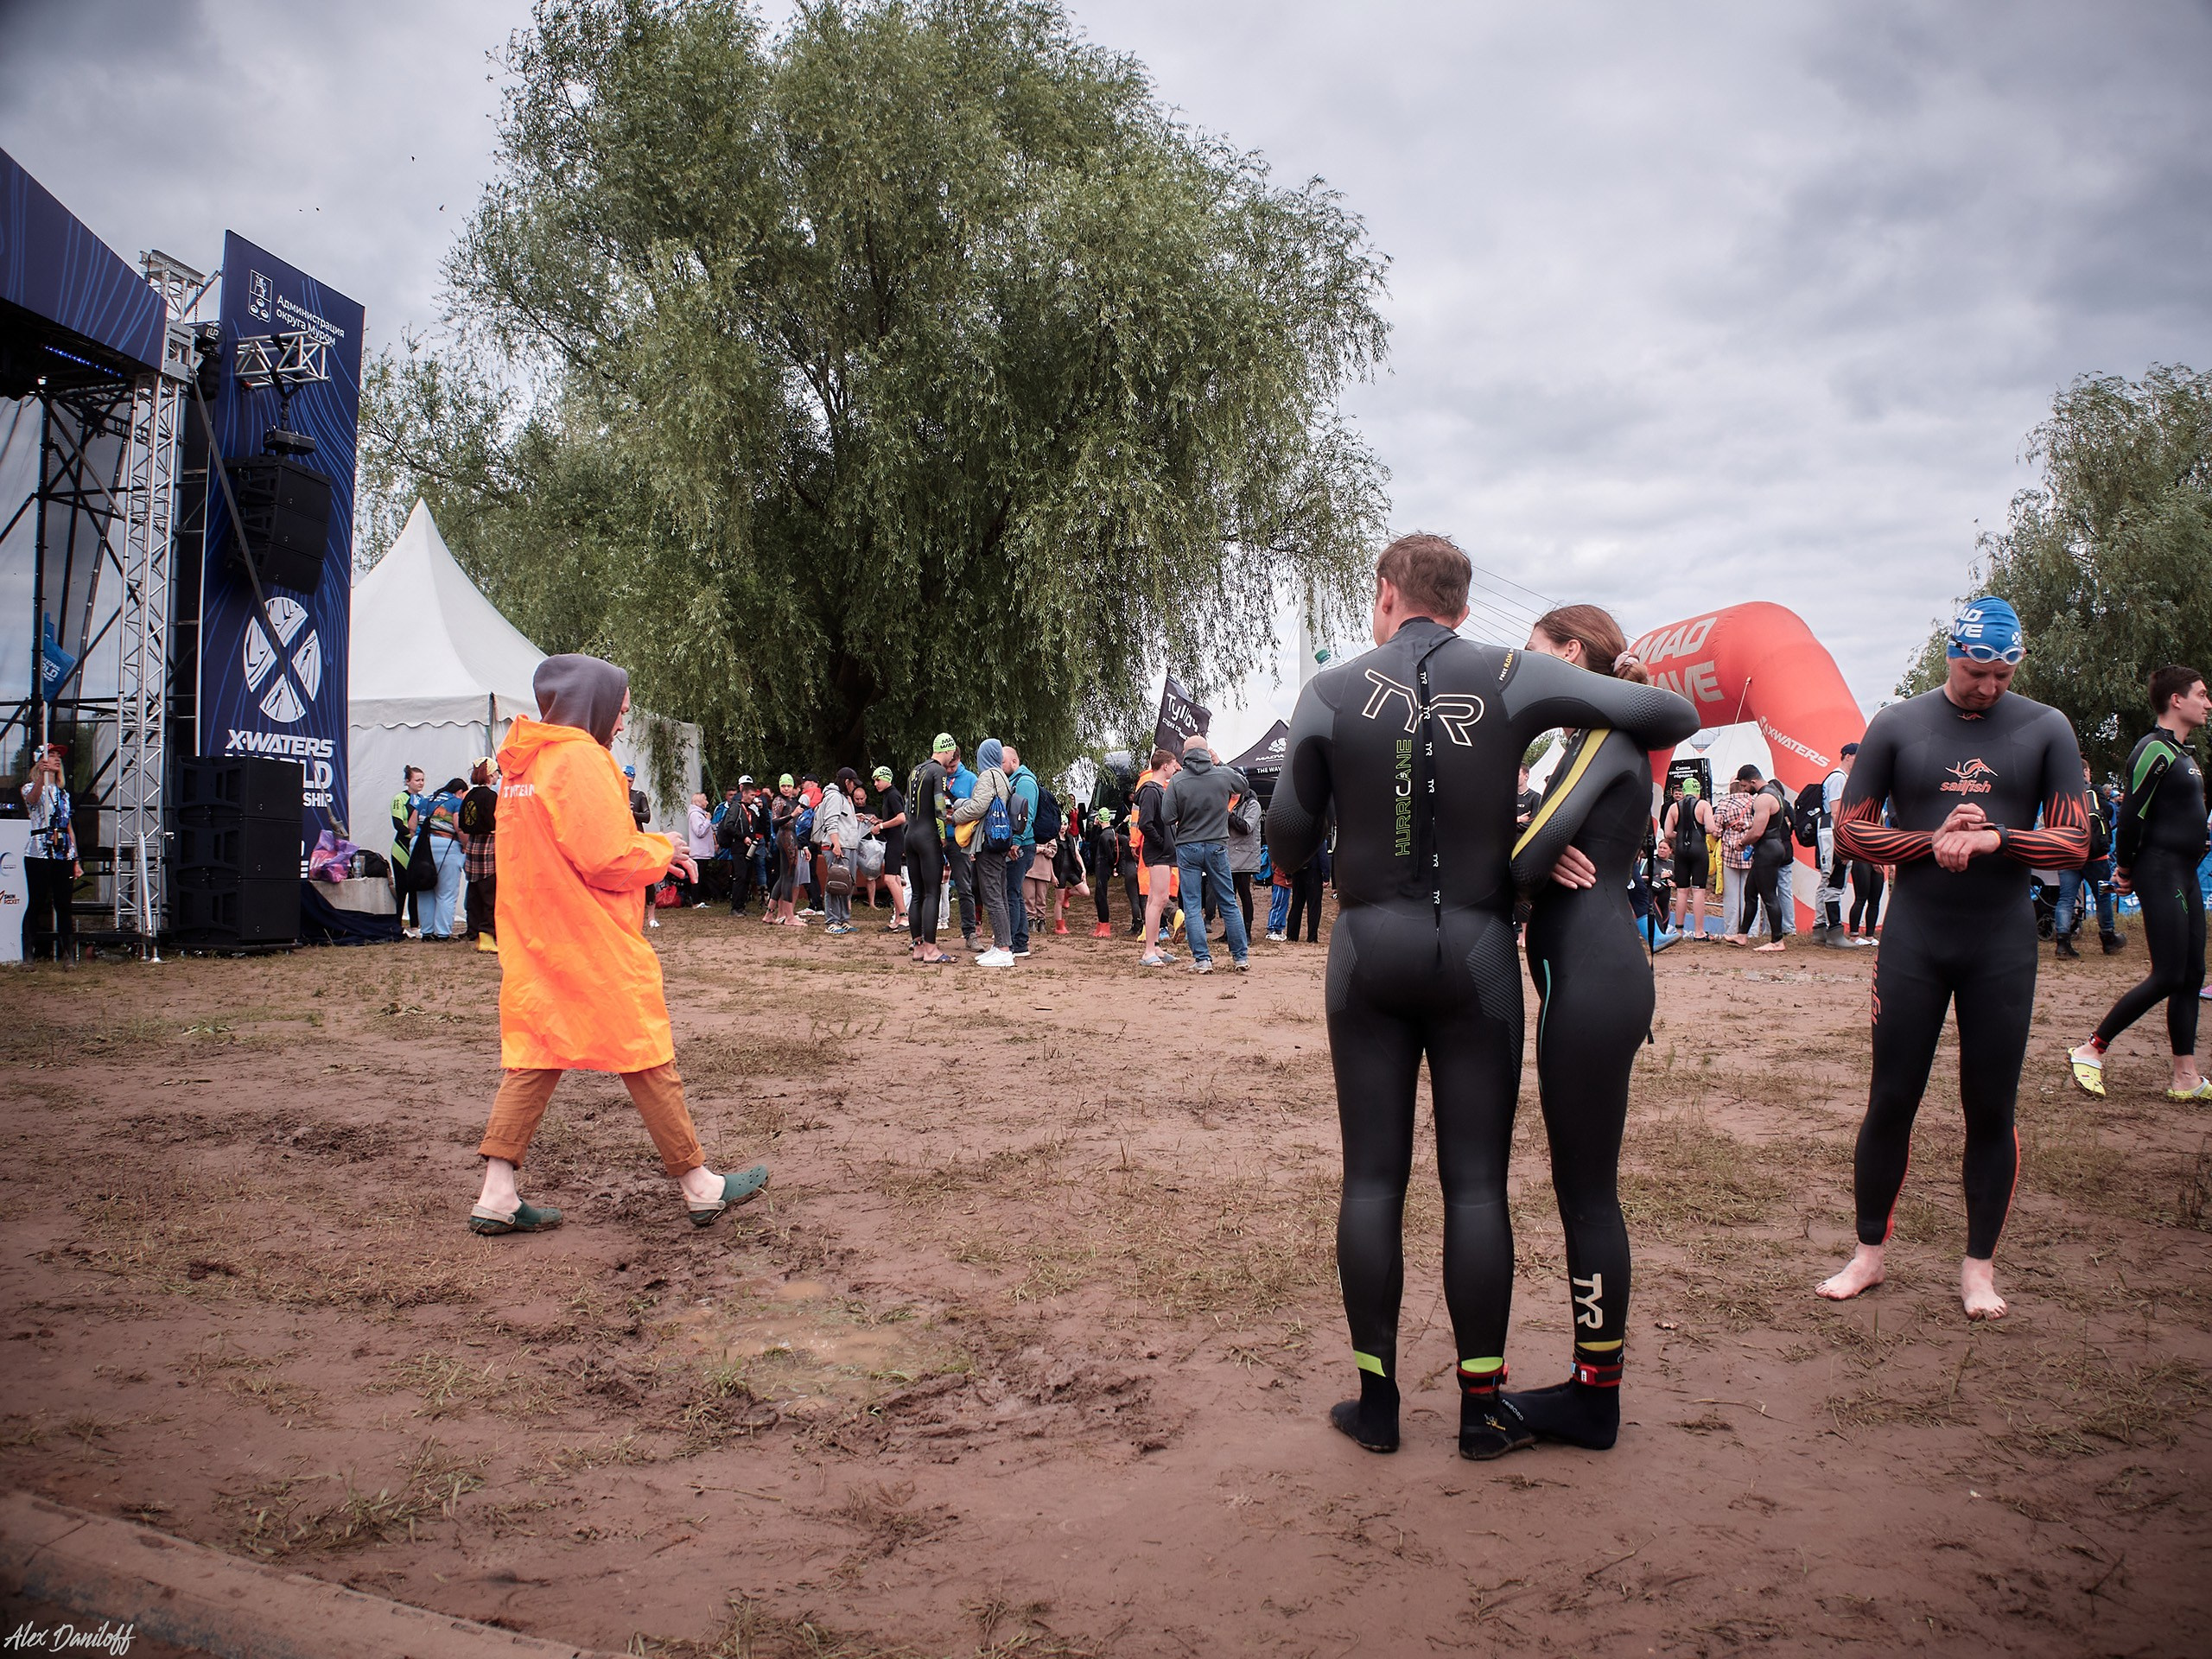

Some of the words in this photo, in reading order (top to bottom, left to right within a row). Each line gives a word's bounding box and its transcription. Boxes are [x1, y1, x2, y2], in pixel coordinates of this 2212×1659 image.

[276, 295, 345, 339] Администрация
[276, 308, 306, 331] округа
[308, 321, 336, 346] Муром
[1959, 608, 1984, 622] AD
[1633, 617, 1718, 664] MAD
[1420, 671, 1428, 685] TYR
[1645, 660, 1726, 704] AVE
[1361, 668, 1484, 747] TYR
[1422, 705, 1431, 721] TYR
[1395, 740, 1412, 856] HURRICANE
[1939, 779, 1992, 796] sailfish
[1433, 889, 1441, 905] TYR
[1573, 1273, 1604, 1329] TYR
[1501, 1399, 1524, 1421] TRIBORD
